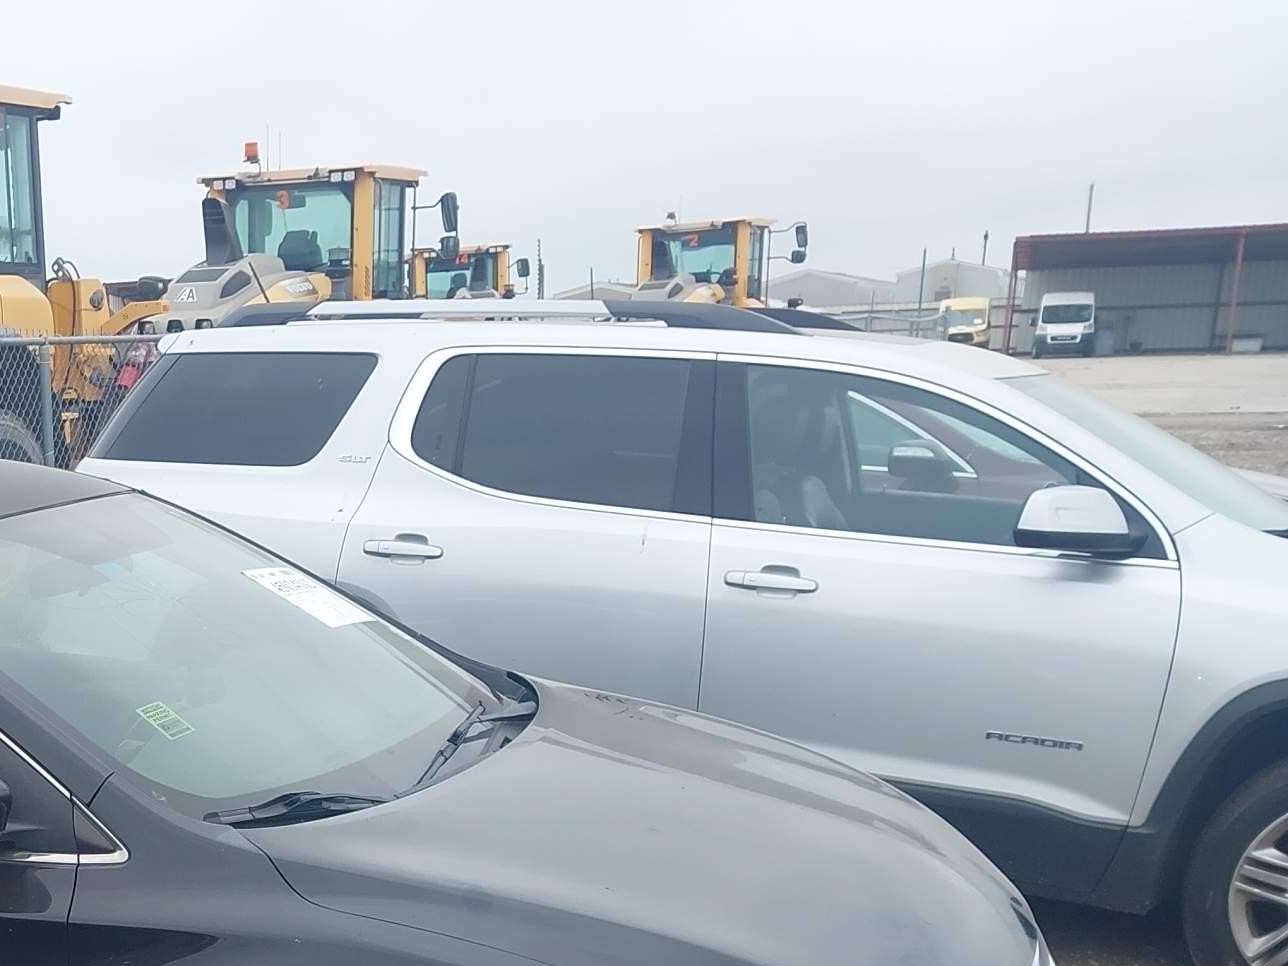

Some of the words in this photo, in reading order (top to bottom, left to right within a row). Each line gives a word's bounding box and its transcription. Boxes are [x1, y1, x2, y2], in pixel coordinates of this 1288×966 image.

[276, 190, 289, 209] 3
[689, 233, 699, 247] 2
[335, 455, 372, 464] SLT
[984, 730, 1084, 752] ACADIA
